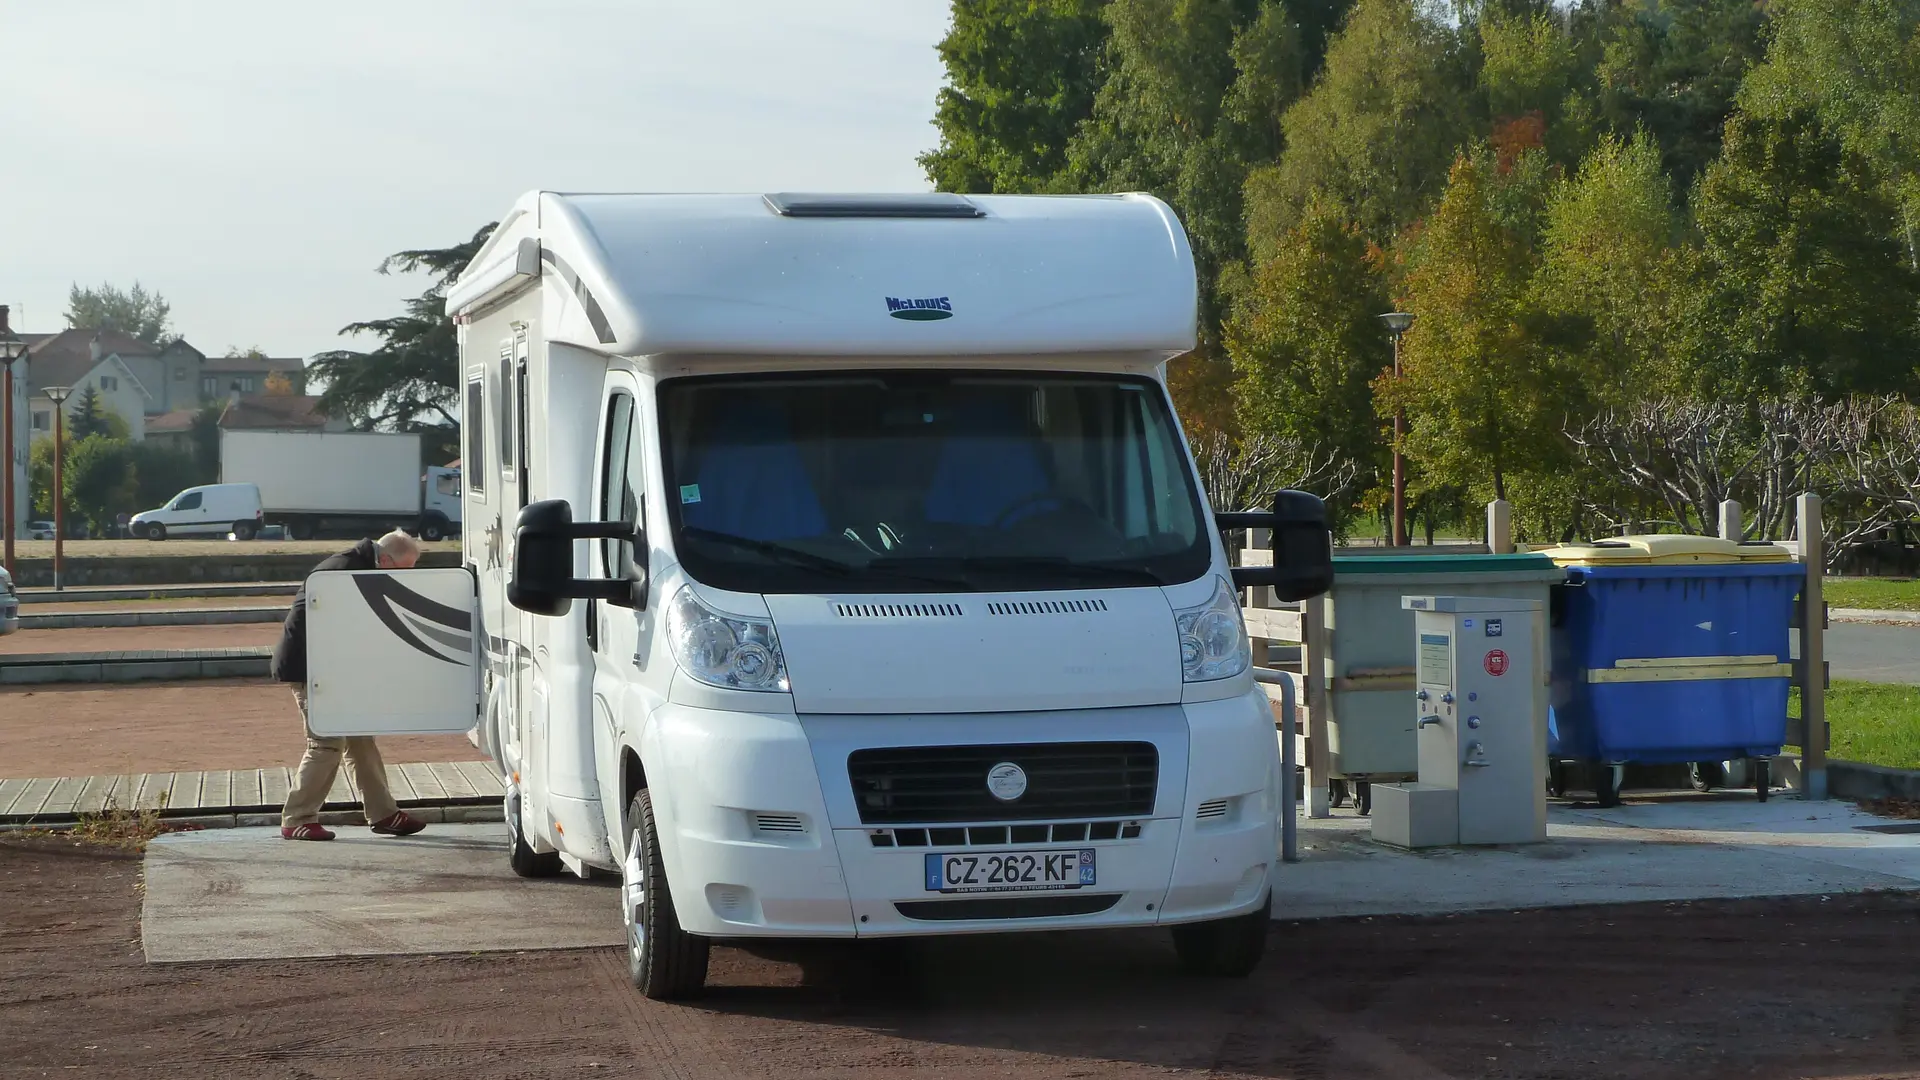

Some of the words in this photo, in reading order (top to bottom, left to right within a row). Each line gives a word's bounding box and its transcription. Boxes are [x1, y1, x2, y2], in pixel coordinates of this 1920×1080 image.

[932, 875, 938, 883] F
[946, 854, 1077, 885] CZ-262-KF
[1080, 868, 1093, 881] 42
